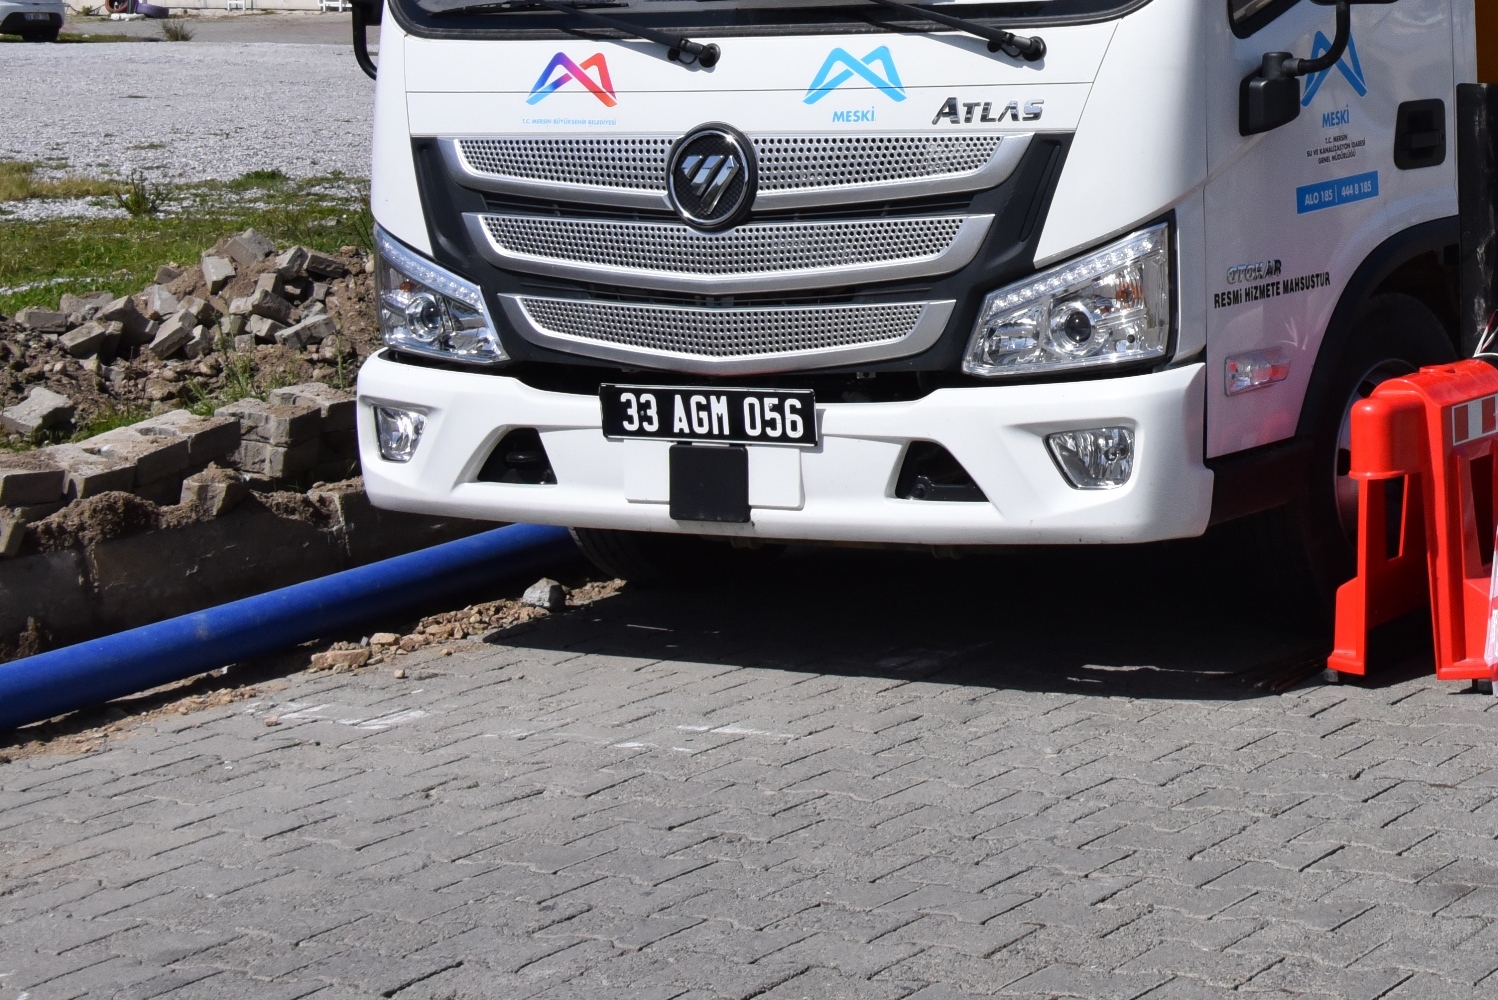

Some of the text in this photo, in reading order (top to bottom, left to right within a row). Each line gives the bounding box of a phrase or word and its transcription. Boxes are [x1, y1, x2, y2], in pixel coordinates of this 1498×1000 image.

[532, 117, 551, 125] MERSİN
[553, 117, 586, 126] BÜYÜKŞEHİR
[588, 118, 616, 126] BELEDİYESİ
[832, 106, 875, 122] MESKİ
[1322, 104, 1349, 128] MESKİ
[1333, 133, 1347, 143] MERSİN
[1313, 148, 1318, 156] VE
[1319, 143, 1350, 154] KANALİZASYON
[1351, 138, 1365, 148] İDARESİ
[1318, 150, 1356, 164] GENEL MÜDÜRLÜĞÜ
[1304, 189, 1332, 206] ALO 185
[1341, 181, 1371, 197] 444 8 185
[1227, 259, 1282, 284] OTOKAR
[1283, 271, 1330, 295] MAHSUSTUR
[620, 392, 804, 438] 33 AGM 056
